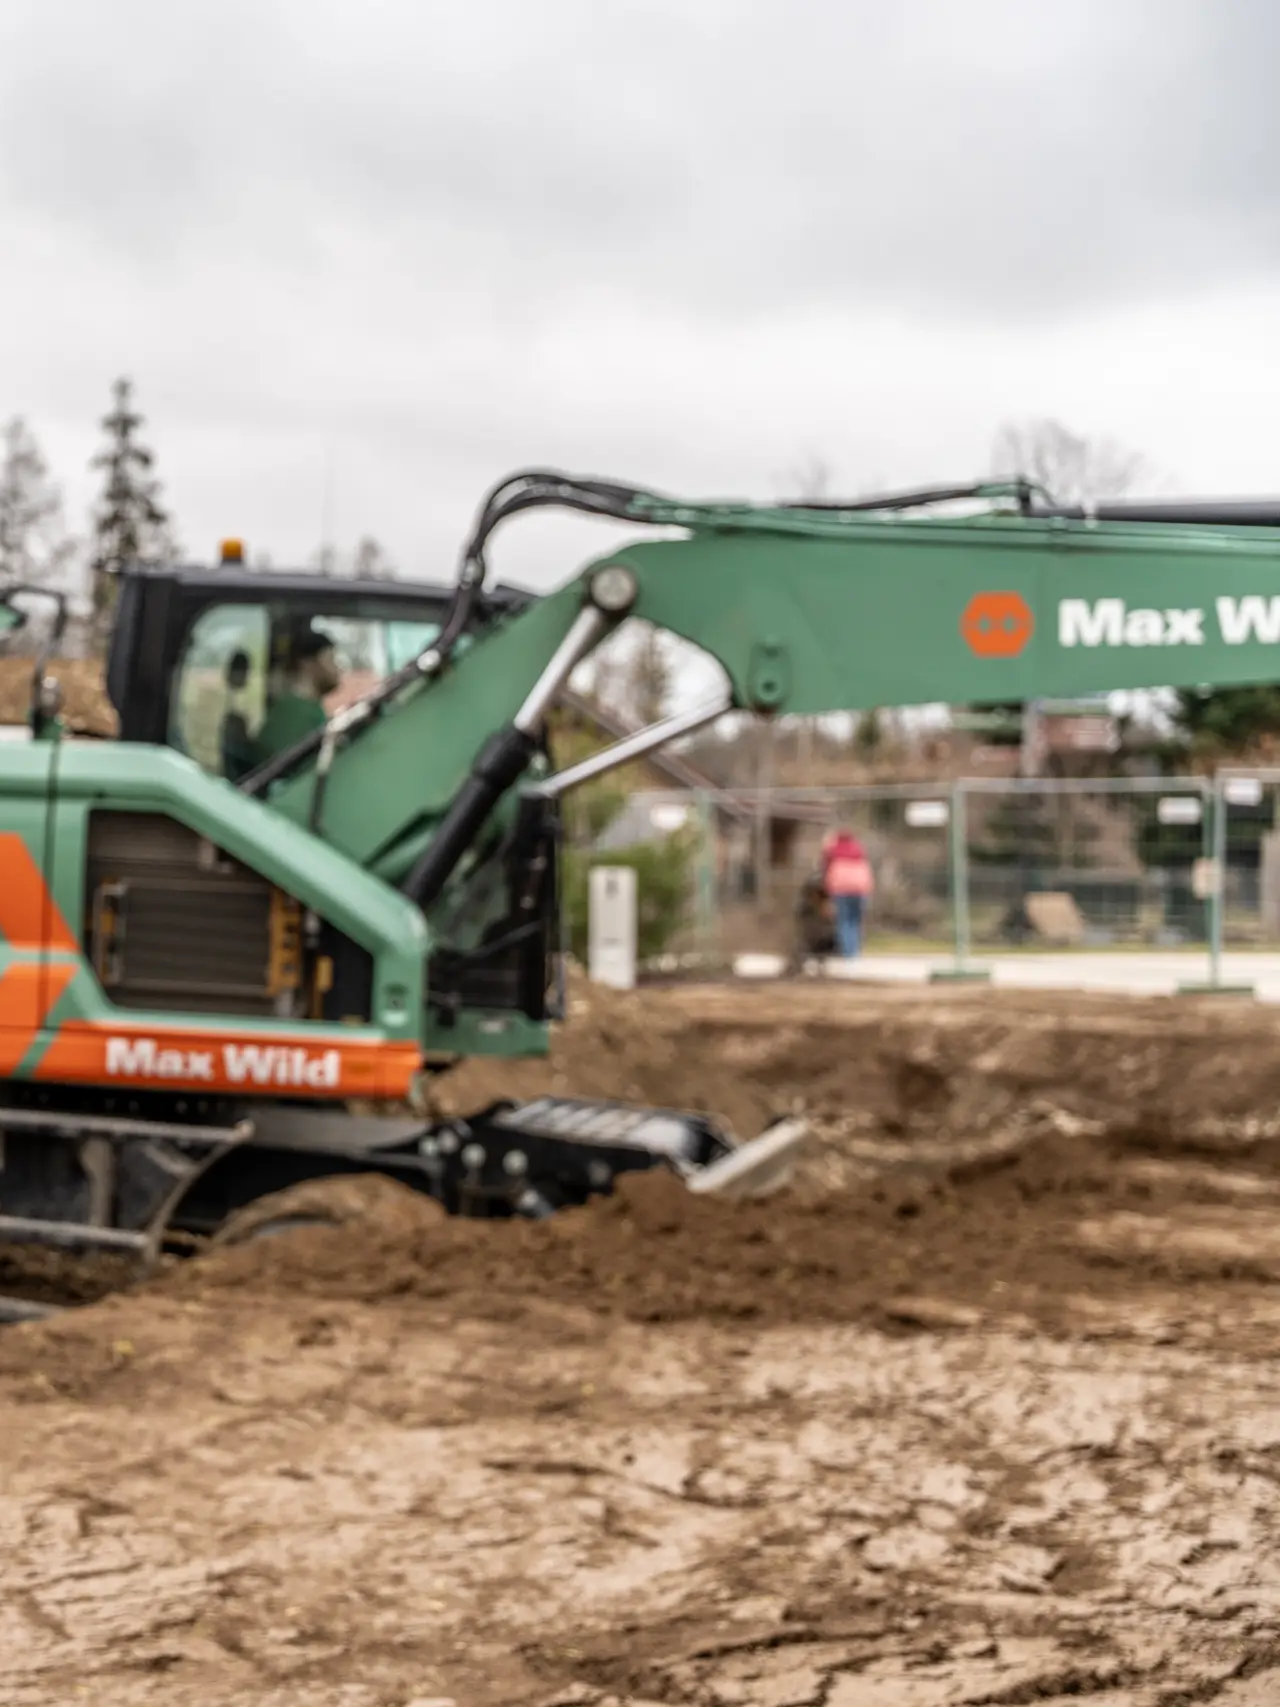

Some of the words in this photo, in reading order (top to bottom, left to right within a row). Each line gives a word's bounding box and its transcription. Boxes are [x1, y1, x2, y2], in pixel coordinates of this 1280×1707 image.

[1058, 598, 1205, 647] Max
[106, 1037, 214, 1081] Max
[222, 1043, 340, 1087] Wild
